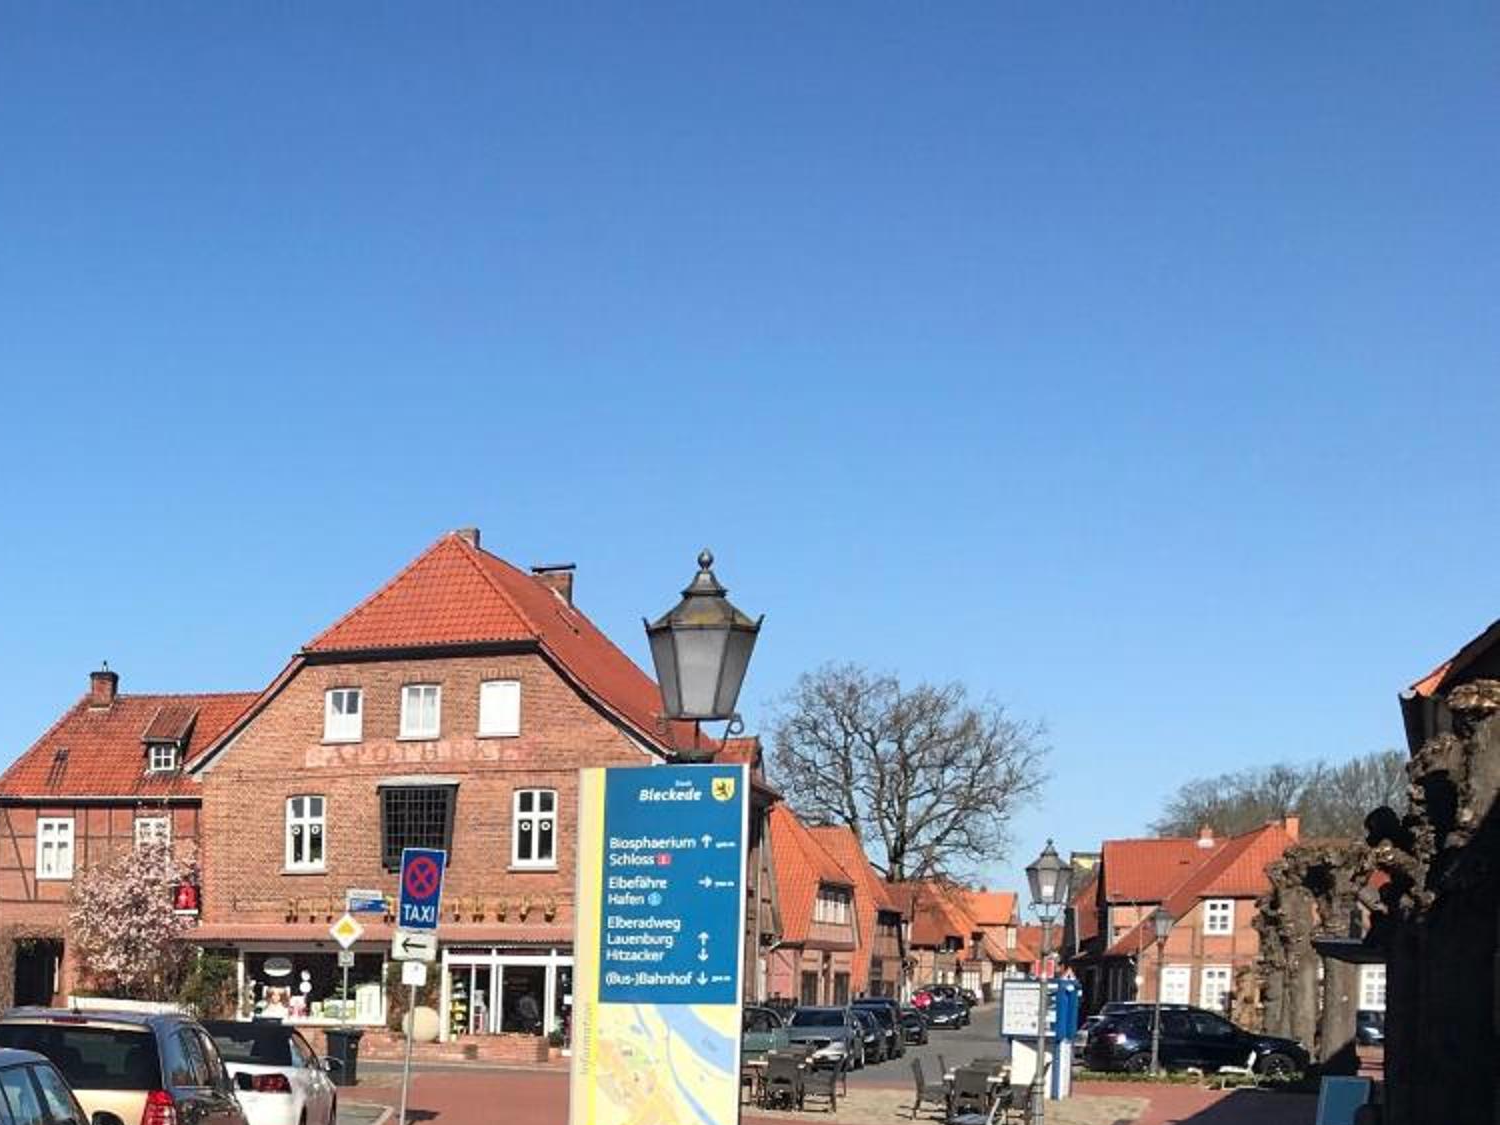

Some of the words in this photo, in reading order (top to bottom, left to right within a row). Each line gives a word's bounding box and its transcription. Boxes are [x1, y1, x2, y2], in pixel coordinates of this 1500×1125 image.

[639, 787, 701, 801] Bleckede
[609, 836, 697, 851] Biosphaerium
[609, 853, 655, 867] Schloss
[608, 875, 667, 889] Elbefähre
[607, 891, 645, 905] Hafen
[403, 902, 436, 923] TAXI
[607, 915, 681, 932] Elberadweg
[607, 932, 674, 949] Lauenburg
[606, 949, 665, 962] Hitzacker
[605, 972, 693, 987] (Bus-)Bahnhof
